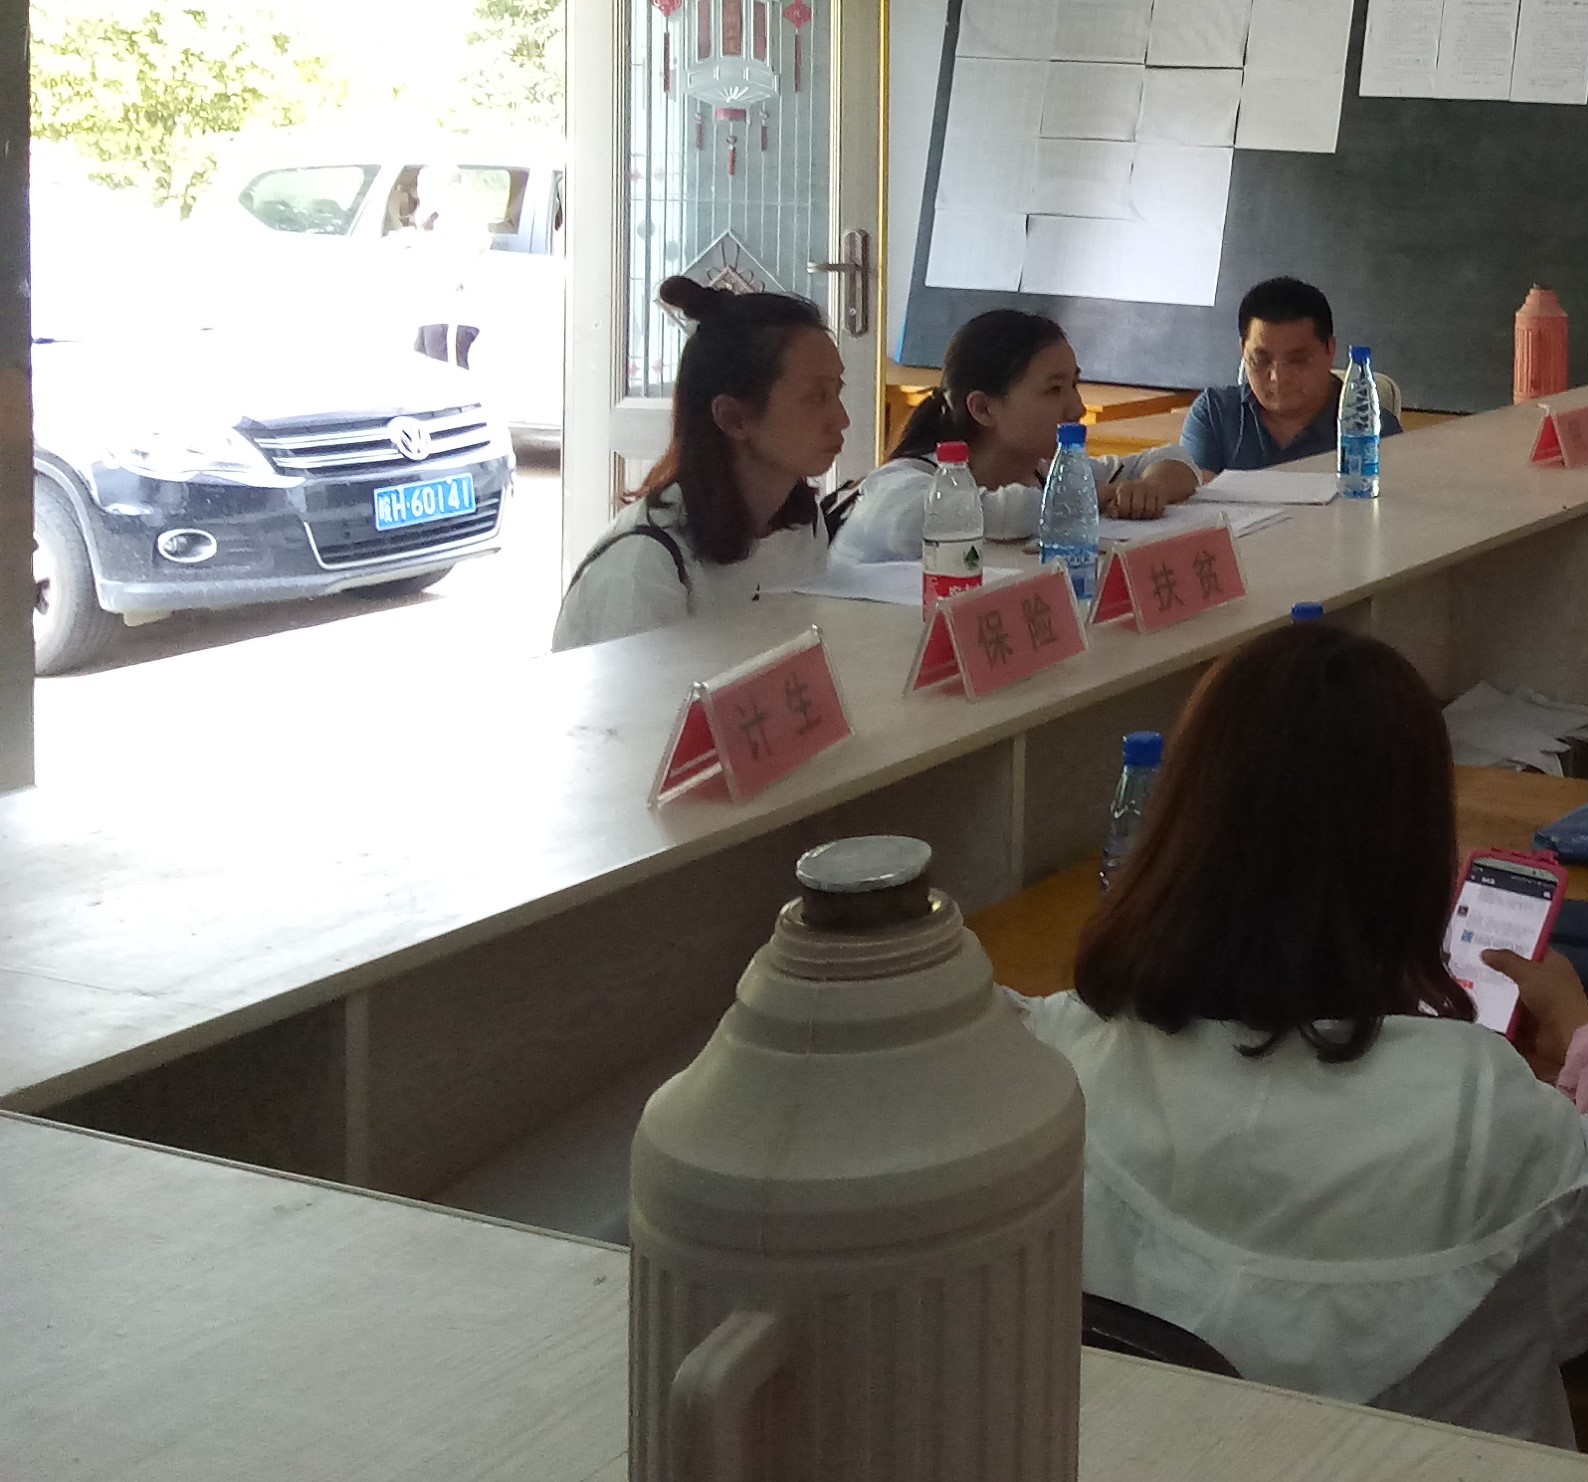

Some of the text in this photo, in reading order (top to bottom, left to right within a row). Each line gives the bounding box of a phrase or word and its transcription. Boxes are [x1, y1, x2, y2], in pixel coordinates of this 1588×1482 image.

[1150, 549, 1224, 612] 扶贫
[977, 593, 1059, 671] 保险
[737, 669, 823, 762] 计生
